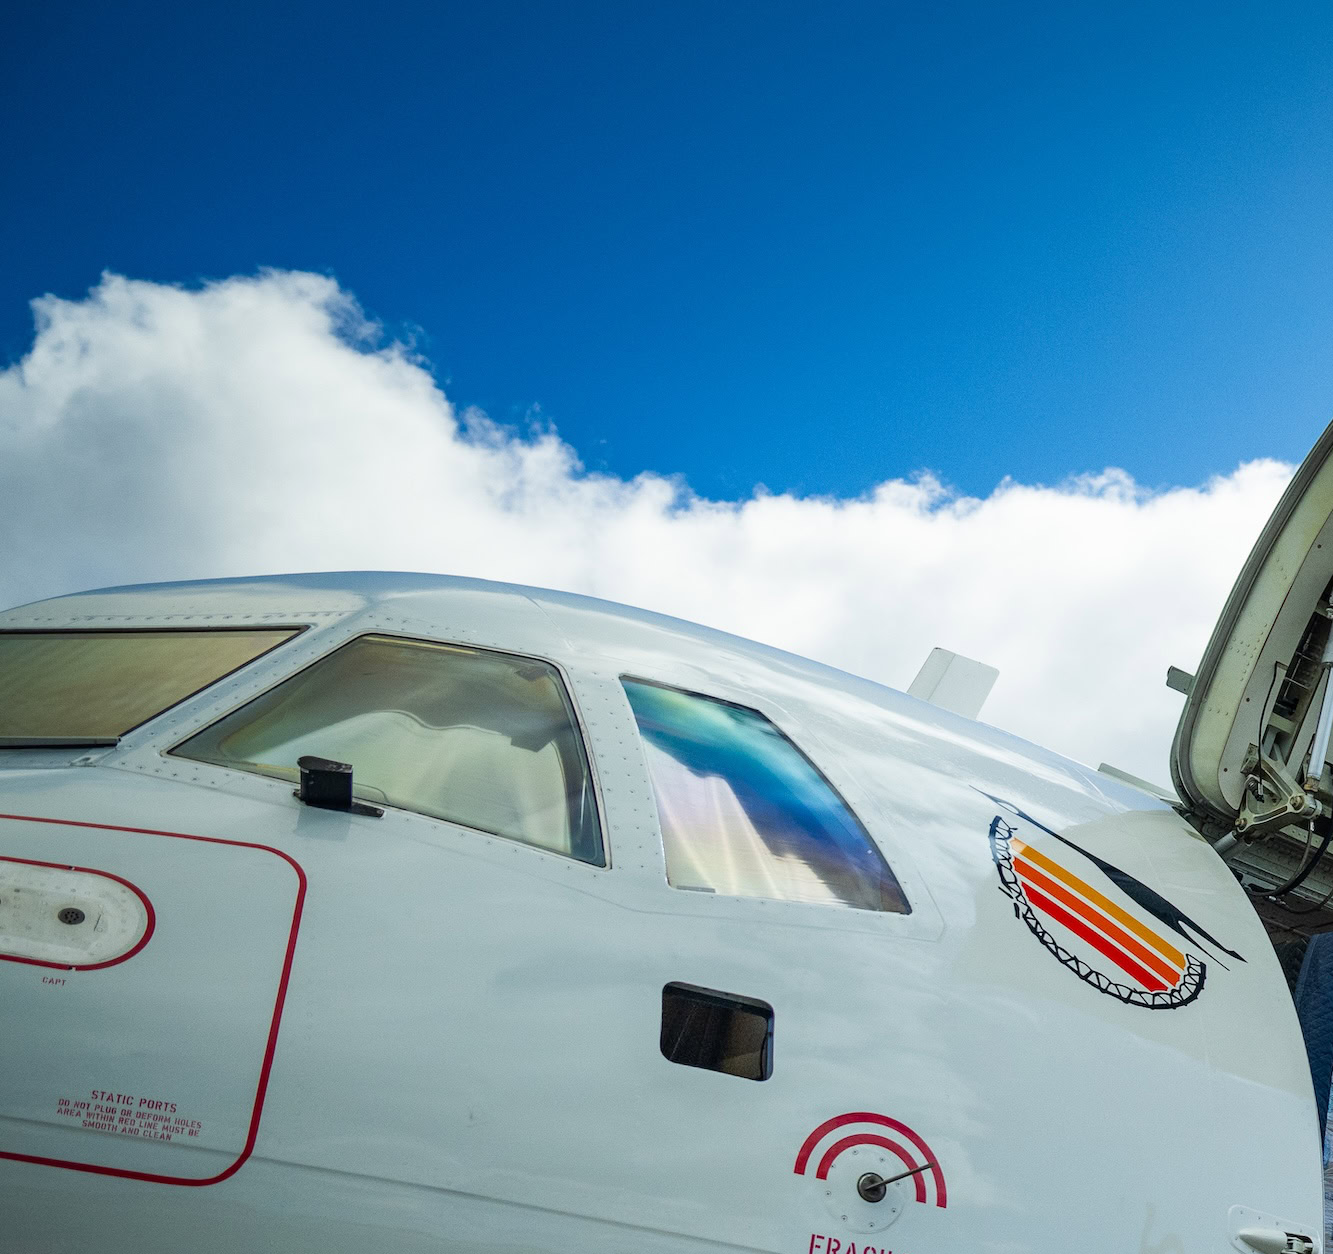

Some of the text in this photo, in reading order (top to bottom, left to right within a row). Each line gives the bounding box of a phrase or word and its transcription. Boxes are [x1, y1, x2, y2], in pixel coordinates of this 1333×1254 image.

[42, 976, 67, 986] CAPT
[91, 1090, 177, 1113] STATIC PORTS
[57, 1107, 200, 1137] AREA WITHIN RED LINE MUST BE
[58, 1098, 202, 1129] DO NOT PLUG OR DEFORM HOLES
[82, 1120, 172, 1141] SMOOTH AND CLEAN
